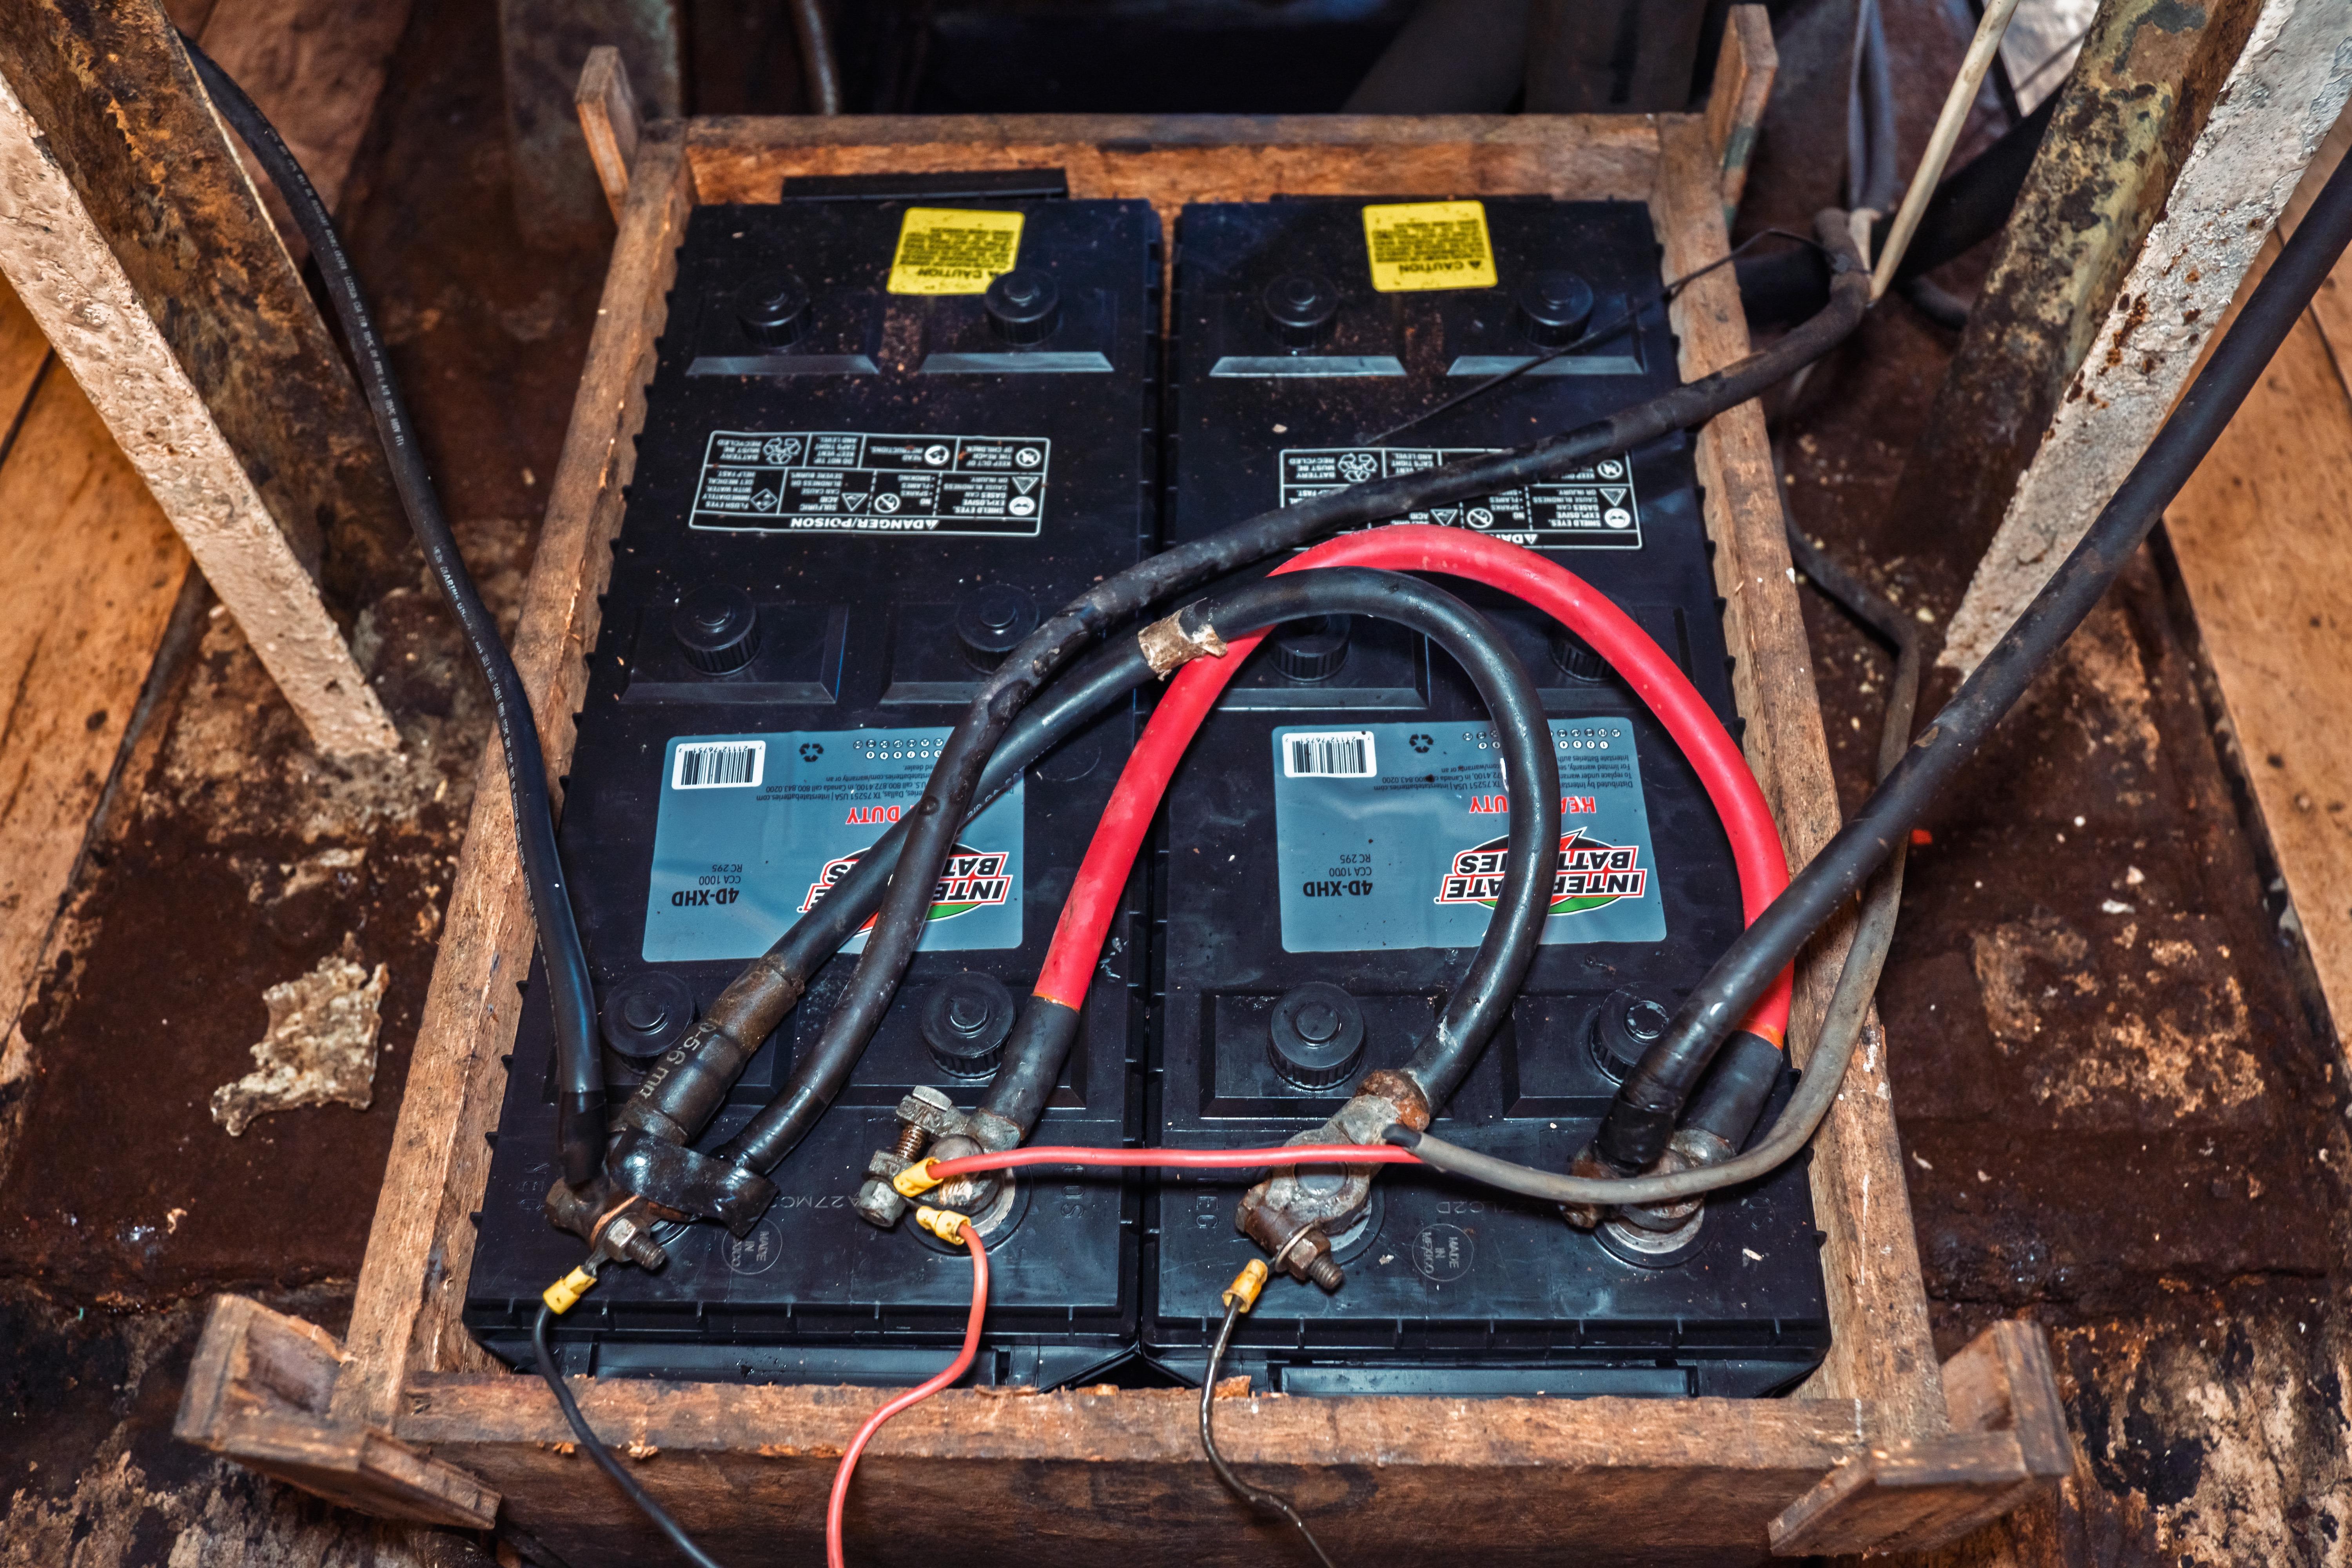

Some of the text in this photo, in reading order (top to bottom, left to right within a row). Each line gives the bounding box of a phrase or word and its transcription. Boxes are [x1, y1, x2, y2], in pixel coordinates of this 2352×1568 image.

[916, 269, 982, 279] CAUTION
[1399, 261, 1465, 275] CAUTION
[789, 517, 924, 529] DANGER/POISON
[493, 683, 502, 702] CABLE
[855, 782, 901, 791] 800.872.4100,
[1470, 781, 1490, 789] 75251
[1588, 780, 1595, 788] by
[1469, 795, 1508, 813] UTY
[846, 806, 900, 824] DUTY
[1340, 854, 1370, 864] RC 295
[1458, 851, 1630, 874] BATTIES
[712, 864, 742, 873] RC 295
[1329, 867, 1372, 877] CCA 1000
[699, 875, 741, 885] CCA 1000
[1446, 874, 1640, 898] INTERATE
[1303, 880, 1373, 897] 4D-XHD
[671, 887, 739, 907] 4D-XHD
[1449, 1237, 1459, 1268] MADE
